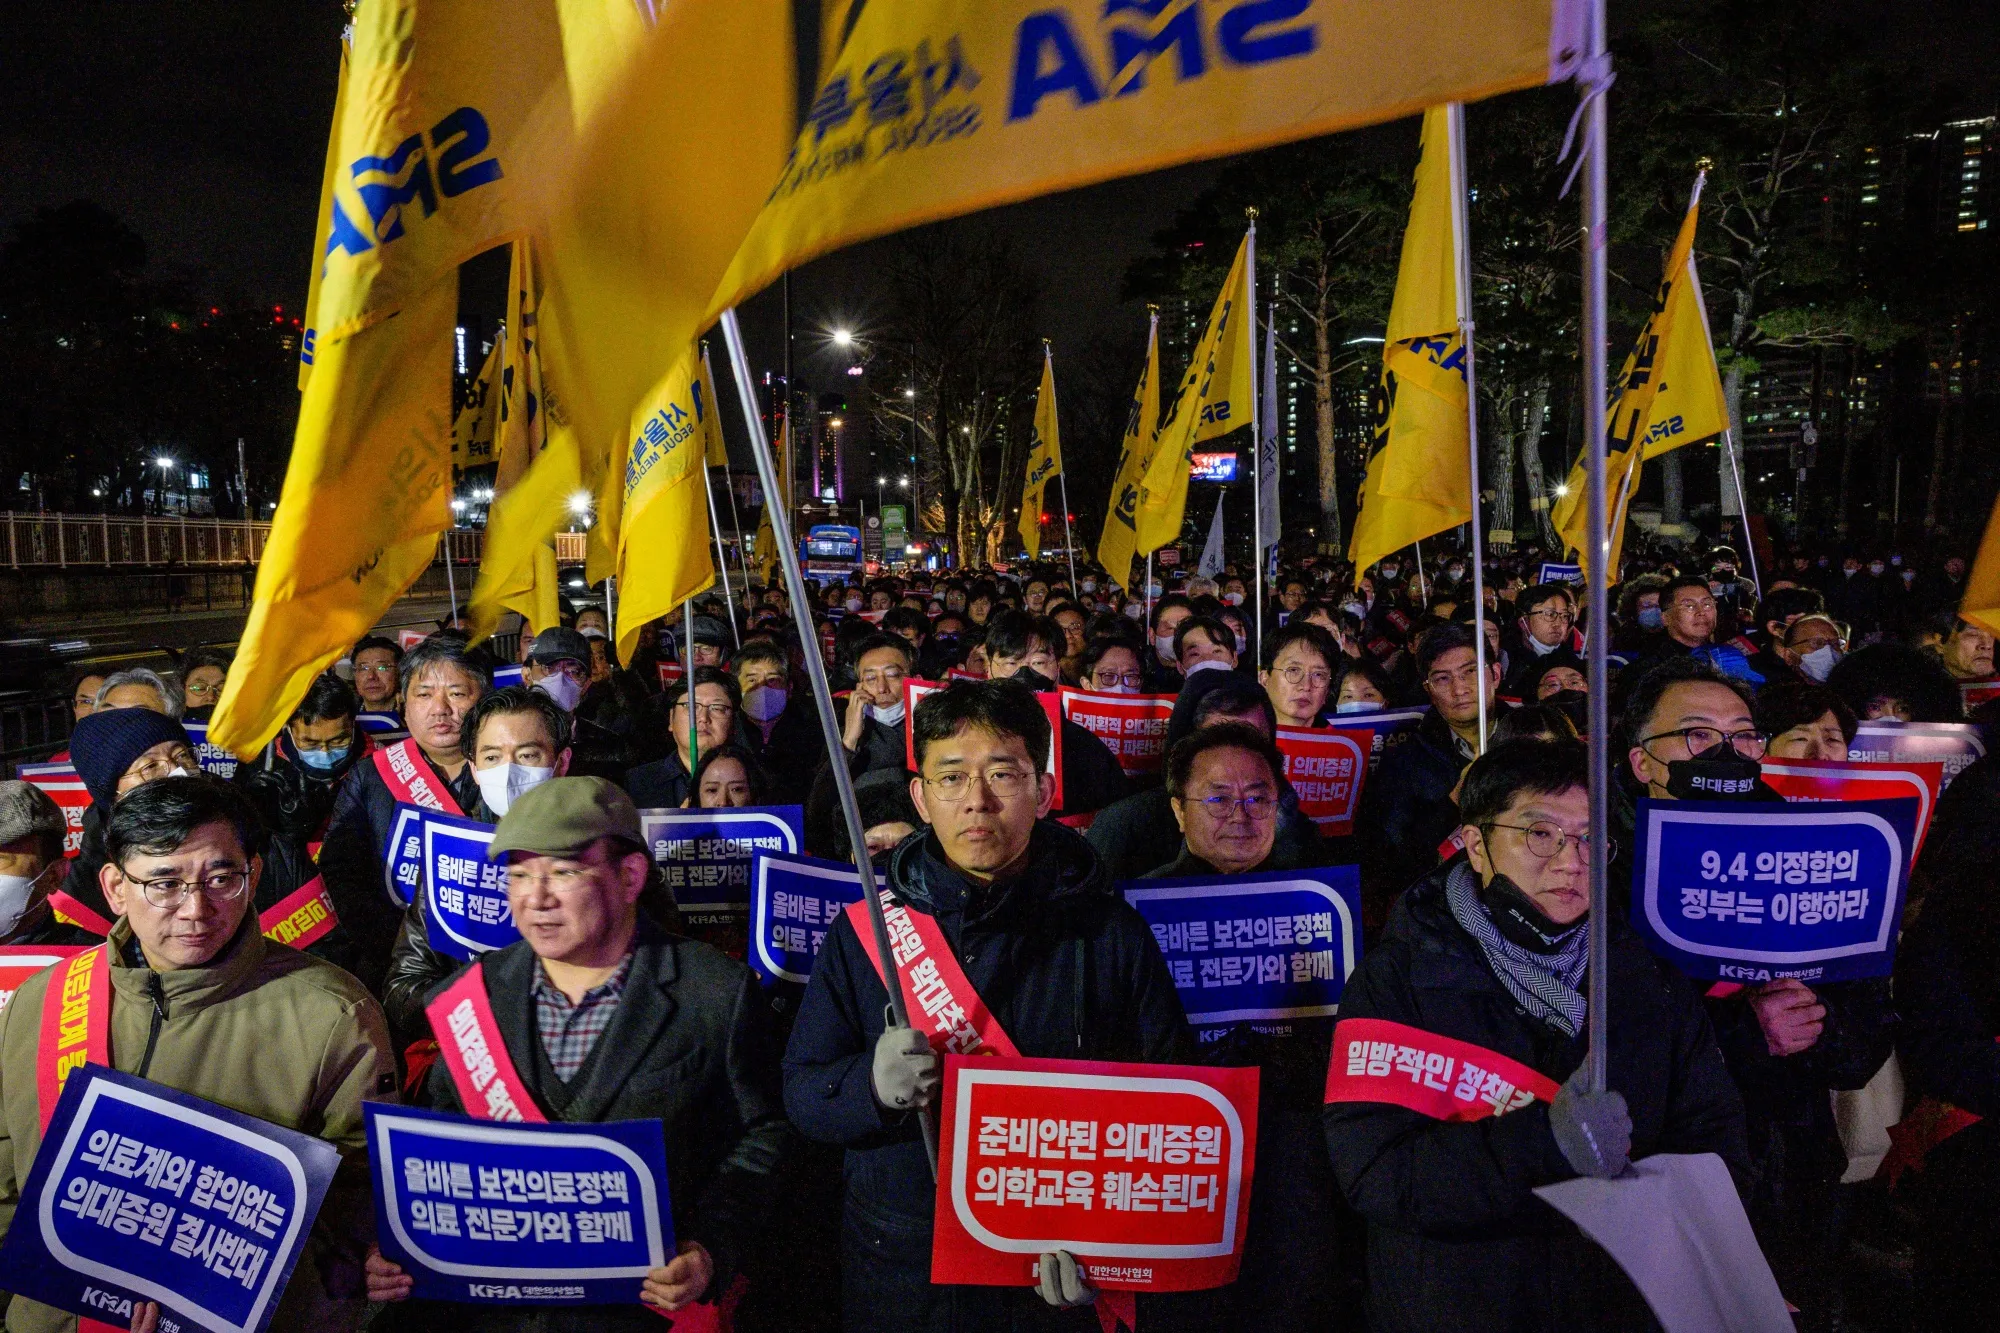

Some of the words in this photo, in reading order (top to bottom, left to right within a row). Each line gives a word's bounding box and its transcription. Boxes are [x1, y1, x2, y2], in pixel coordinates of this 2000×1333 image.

[208, 762, 238, 778] 이행
[1293, 757, 1353, 777] 의대증원
[654, 839, 695, 862] 올바른
[1701, 850, 1748, 883] 9.4
[1754, 849, 1859, 884] 의정합의
[438, 854, 478, 887] 올바른
[439, 886, 465, 916] 의료
[468, 894, 517, 927] 전문가
[773, 891, 821, 923] 올바른
[1680, 887, 1764, 925] 정부는
[1771, 888, 1869, 926] 이행하라
[772, 926, 808, 955] 의료
[1151, 921, 1208, 952] 올바른
[1214, 912, 1332, 948] 보건의료정책
[1169, 960, 1195, 988] 료
[1200, 954, 1286, 988] 전문가와
[1290, 950, 1334, 982] 함께
[1720, 964, 1771, 981] KMA
[57, 950, 99, 1050] 의료체계
[1347, 1041, 1454, 1091] 일방적인
[978, 1116, 1097, 1160] 준비안된
[1104, 1122, 1222, 1165] 의대증원
[80, 1130, 195, 1198] 의료계와
[190, 1165, 285, 1239] 합의없는
[404, 1157, 473, 1199] 올바른
[478, 1166, 629, 1205] 보건의료정책
[974, 1167, 1094, 1210] 의학교육
[1101, 1172, 1218, 1213] 훼손된다
[60, 1177, 177, 1246] 의대증원
[170, 1214, 269, 1290] 결사반대
[411, 1200, 461, 1238] 의료
[465, 1207, 572, 1243] 전문가와
[575, 1211, 633, 1243] 함께
[1089, 1265, 1152, 1278] 대한의사협회
[81, 1287, 132, 1318] KMA
[469, 1284, 523, 1299] KMA
